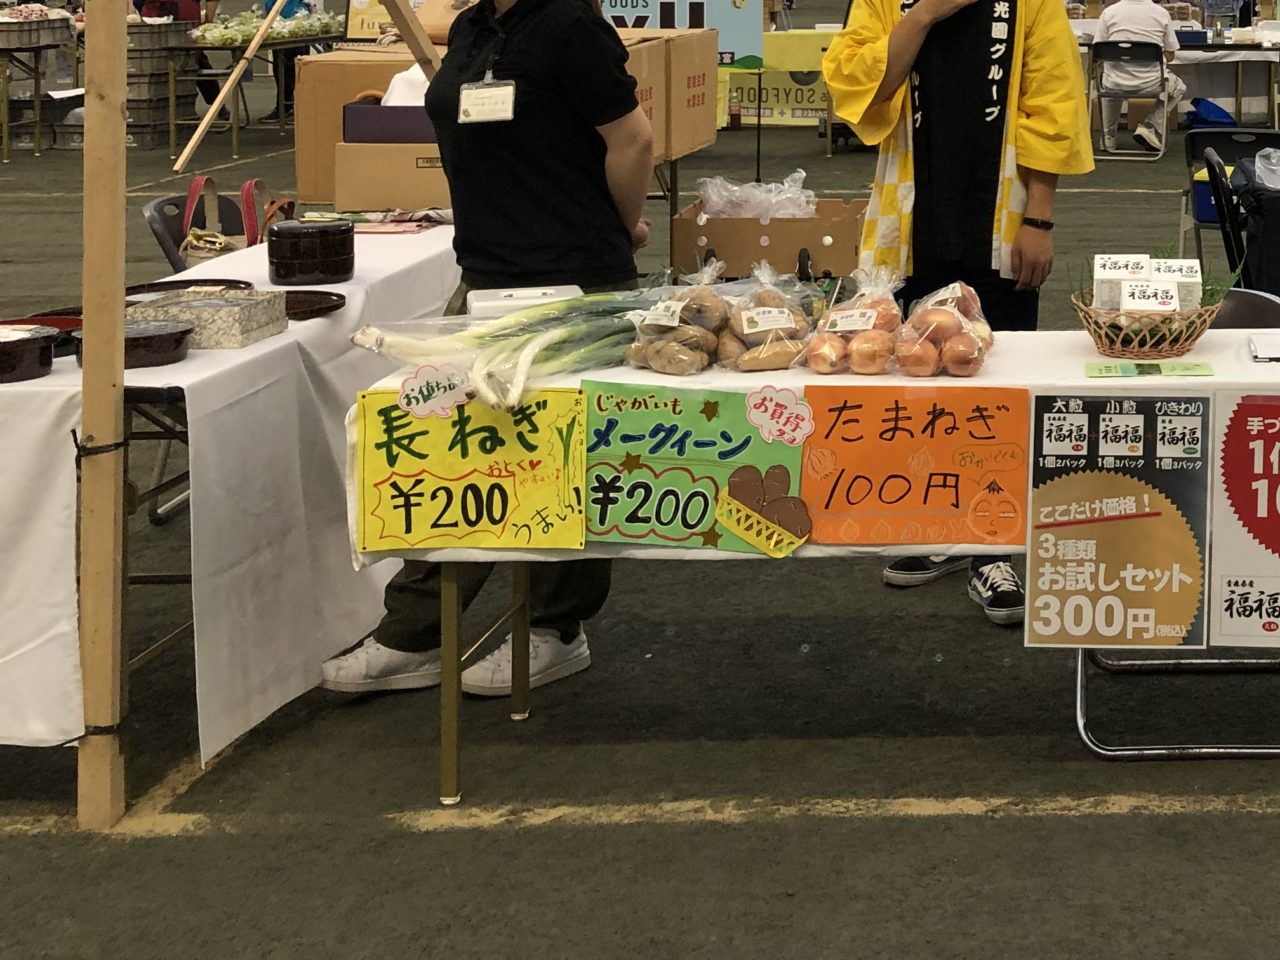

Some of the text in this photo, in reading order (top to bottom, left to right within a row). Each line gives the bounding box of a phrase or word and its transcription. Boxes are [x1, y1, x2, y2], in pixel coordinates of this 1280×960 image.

[596, 393, 683, 416] じゃがいも
[1052, 398, 1084, 414] 大粒
[1106, 399, 1137, 414] 小粒
[1155, 401, 1203, 416] ひきわり
[824, 399, 1010, 442] たまねぎ
[374, 400, 548, 468] 長ねぎ
[1045, 422, 1087, 444] 福福
[1101, 424, 1142, 444] 福福
[1158, 426, 1200, 447] 福福
[486, 460, 527, 477] おとく
[1038, 456, 1087, 469] 1個2パック
[1097, 456, 1145, 469] 1個3パック
[1155, 458, 1203, 470] 1個3パック
[824, 468, 960, 510] 100円
[389, 478, 508, 534] ¥200
[590, 473, 710, 530] ¥200
[1039, 493, 1151, 522] ここだけ価格！
[1037, 533, 1097, 560] 3種類
[1037, 562, 1193, 593] お試しセット
